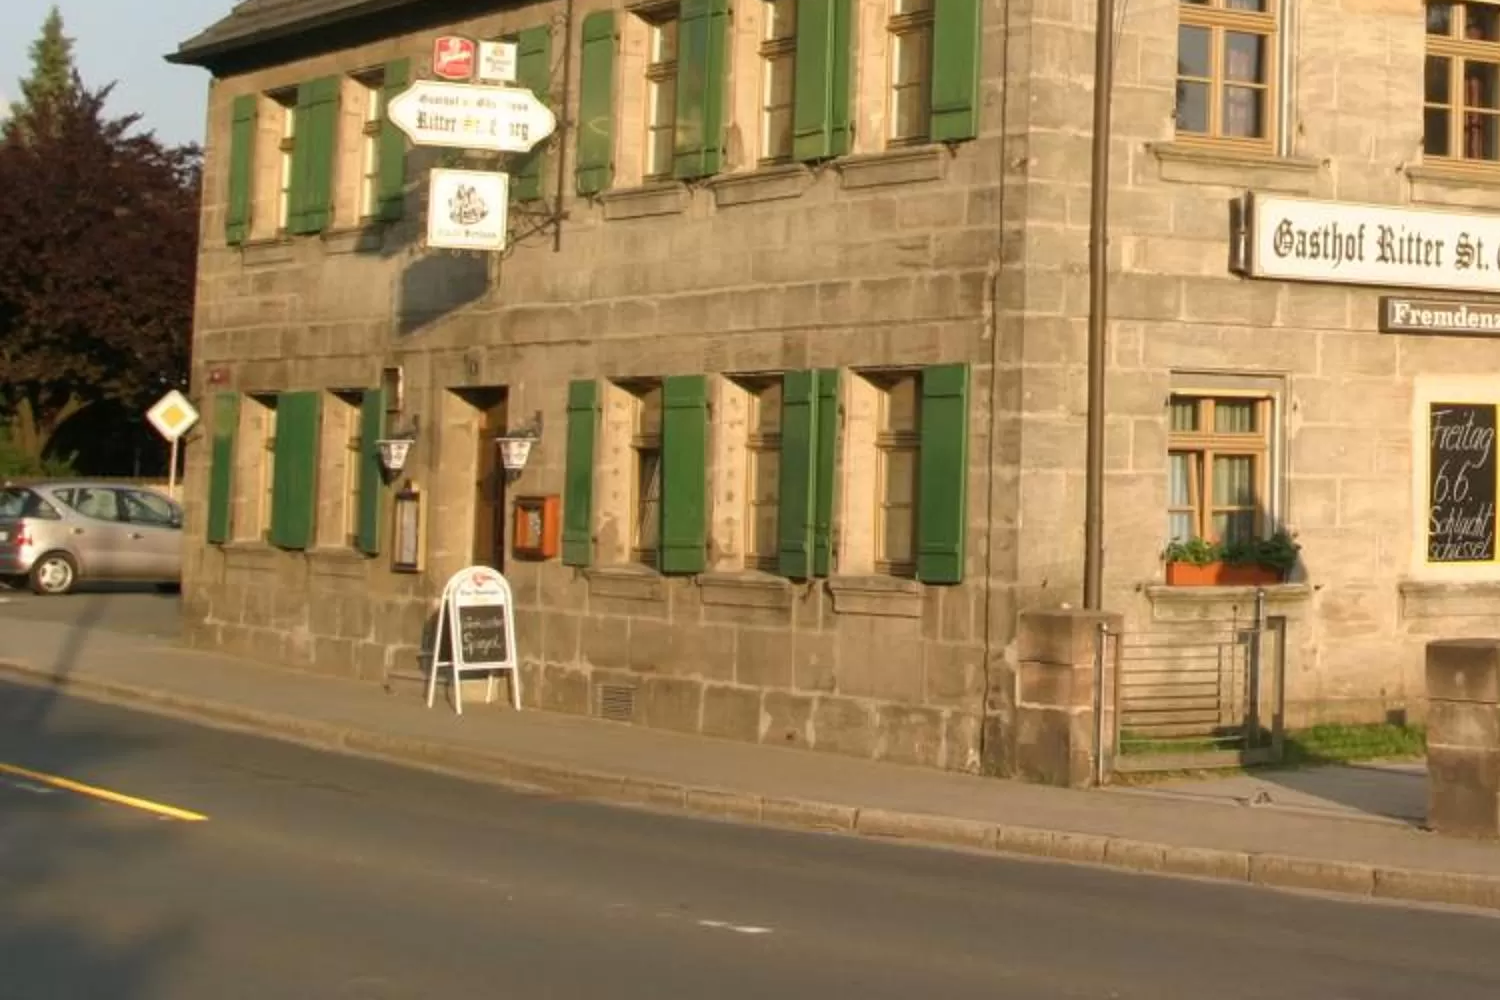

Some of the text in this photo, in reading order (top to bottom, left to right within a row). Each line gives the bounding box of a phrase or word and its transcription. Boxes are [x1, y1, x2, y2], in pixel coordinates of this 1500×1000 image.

[1273, 218, 1366, 269] Gasthof
[1376, 223, 1445, 268] Ritter
[1455, 232, 1489, 270] St.
[1430, 409, 1495, 469] Freitag
[1433, 459, 1473, 503] 6.6.
